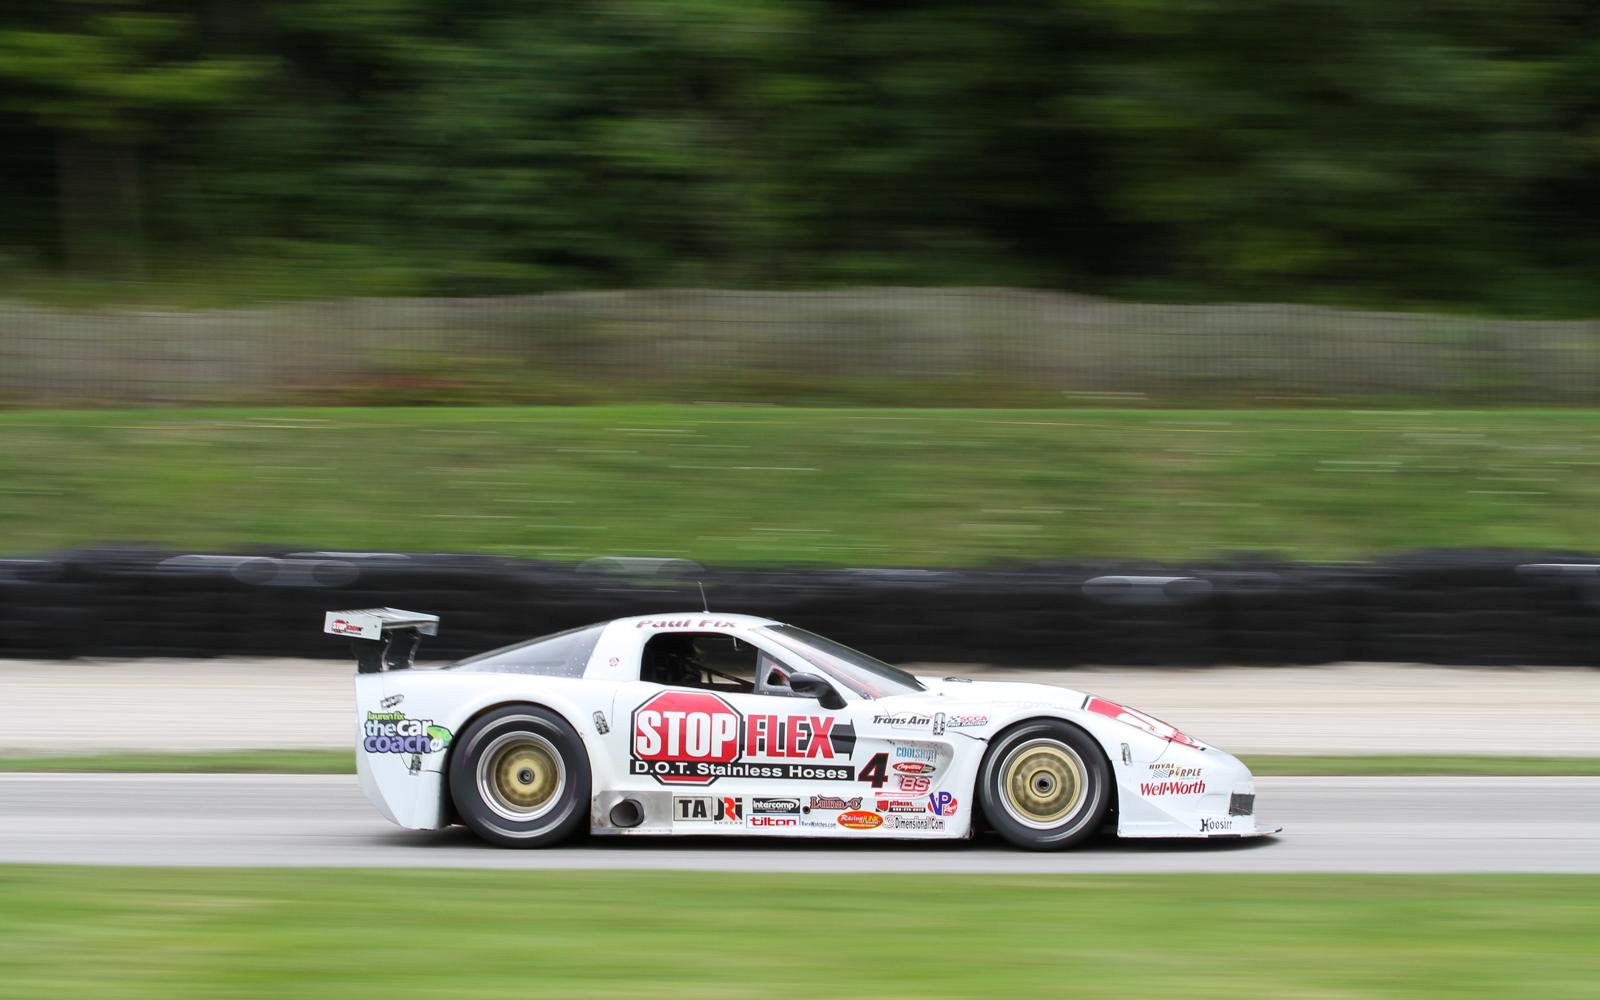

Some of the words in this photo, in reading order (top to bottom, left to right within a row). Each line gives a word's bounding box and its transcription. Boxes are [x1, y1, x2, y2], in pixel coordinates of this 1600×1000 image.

[635, 619, 691, 629] Paul
[698, 619, 738, 628] Fix
[367, 711, 394, 720] lauren
[394, 711, 405, 720] fix
[872, 715, 906, 725] Trans
[907, 715, 931, 725] Am
[365, 719, 397, 737] the
[397, 719, 433, 737] car
[636, 710, 737, 758] STOP
[747, 714, 835, 759] FLEX
[364, 735, 431, 753] coach
[635, 761, 691, 775] D.O.T.
[696, 763, 783, 777] Stainless
[789, 765, 848, 779] Hoses
[857, 752, 889, 788] 4
[678, 799, 707, 818] TA
[753, 800, 795, 811] Intercomp
[929, 791, 952, 816] VP
[750, 816, 797, 827] tilton
